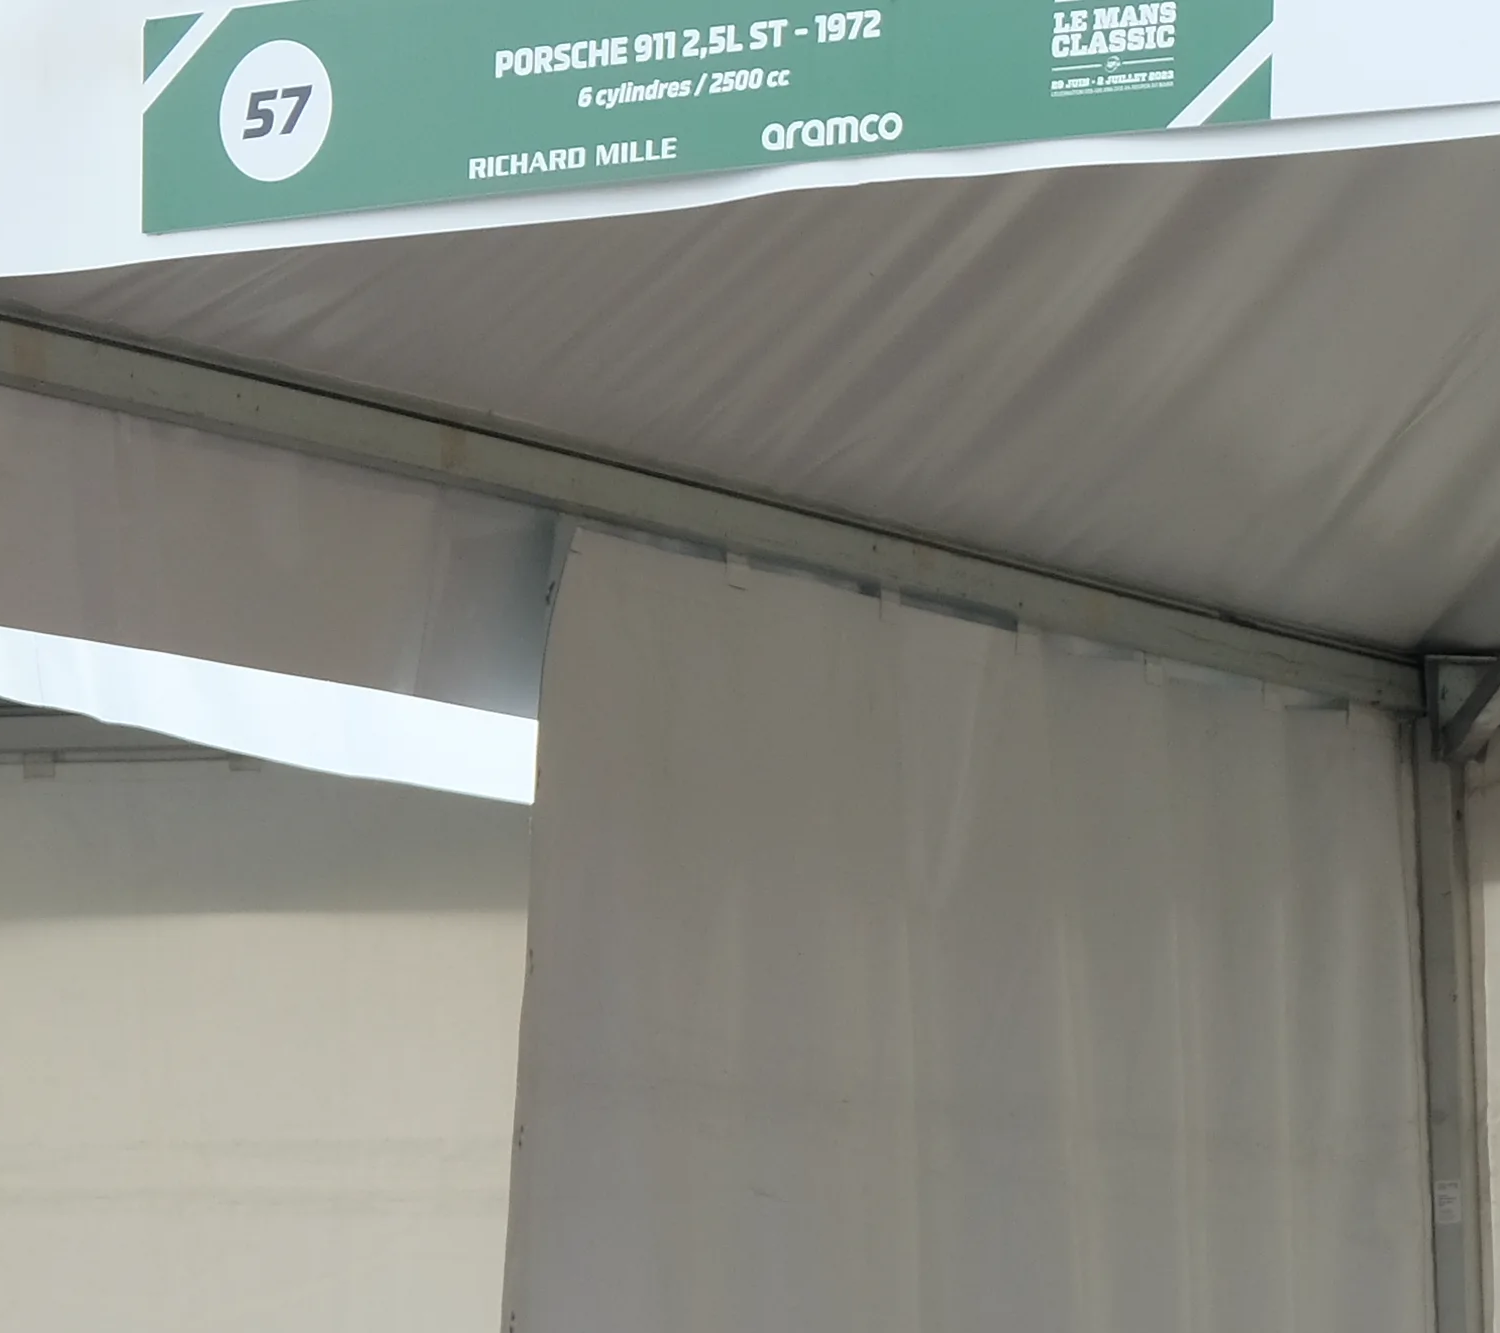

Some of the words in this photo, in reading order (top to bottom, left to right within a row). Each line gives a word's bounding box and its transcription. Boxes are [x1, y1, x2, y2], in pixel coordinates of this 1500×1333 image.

[1053, 9, 1088, 34] LE
[1092, 1, 1177, 30] MANS
[494, 36, 629, 79] PORSCHE
[633, 31, 677, 64] 911
[681, 24, 744, 60] 2,5L
[748, 19, 789, 50] ST
[814, 9, 882, 44] 1972
[1051, 24, 1176, 58] CLASSIC
[577, 86, 593, 108] 6
[595, 76, 692, 109] cylindres
[694, 73, 709, 96] /
[708, 68, 764, 94] 2500
[766, 68, 791, 88] cc
[1051, 79, 1065, 90] 29
[1065, 77, 1090, 89] JUIN
[1105, 72, 1147, 85] JUILLET
[242, 84, 313, 140] 57
[761, 111, 904, 152] aramco
[468, 146, 586, 180] RICHARD
[595, 137, 678, 166] MILLE
